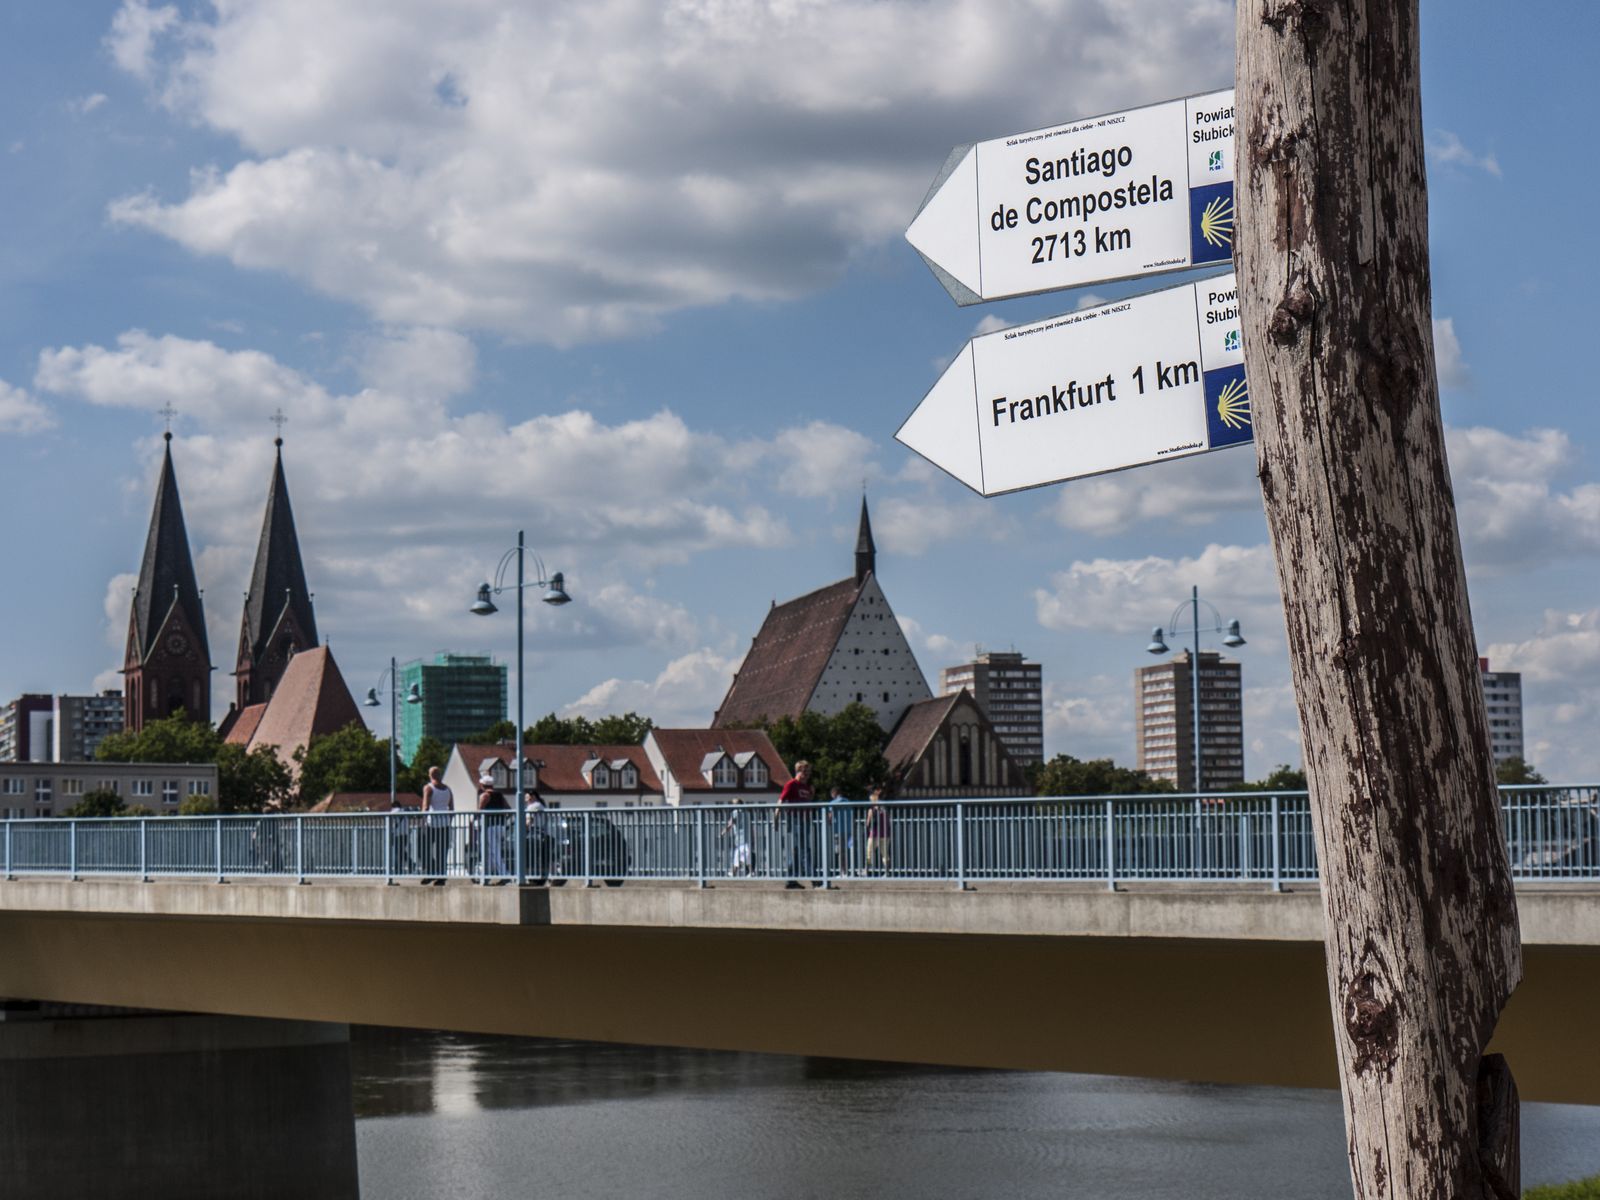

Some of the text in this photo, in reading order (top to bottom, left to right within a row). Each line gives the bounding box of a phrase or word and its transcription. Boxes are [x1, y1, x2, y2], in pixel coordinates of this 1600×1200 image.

[1196, 106, 1234, 125] Powiat
[1193, 124, 1234, 143] Słubick
[1025, 146, 1133, 185] Santiago
[991, 175, 1173, 231] de Compostela
[1031, 226, 1131, 264] 2713 km
[1209, 287, 1238, 305] Powi
[1083, 312, 1097, 320] ciebie
[1112, 303, 1131, 313] NISZCZ
[1206, 305, 1239, 324] Słubi
[992, 360, 1199, 427] Frankfurt 1 km
